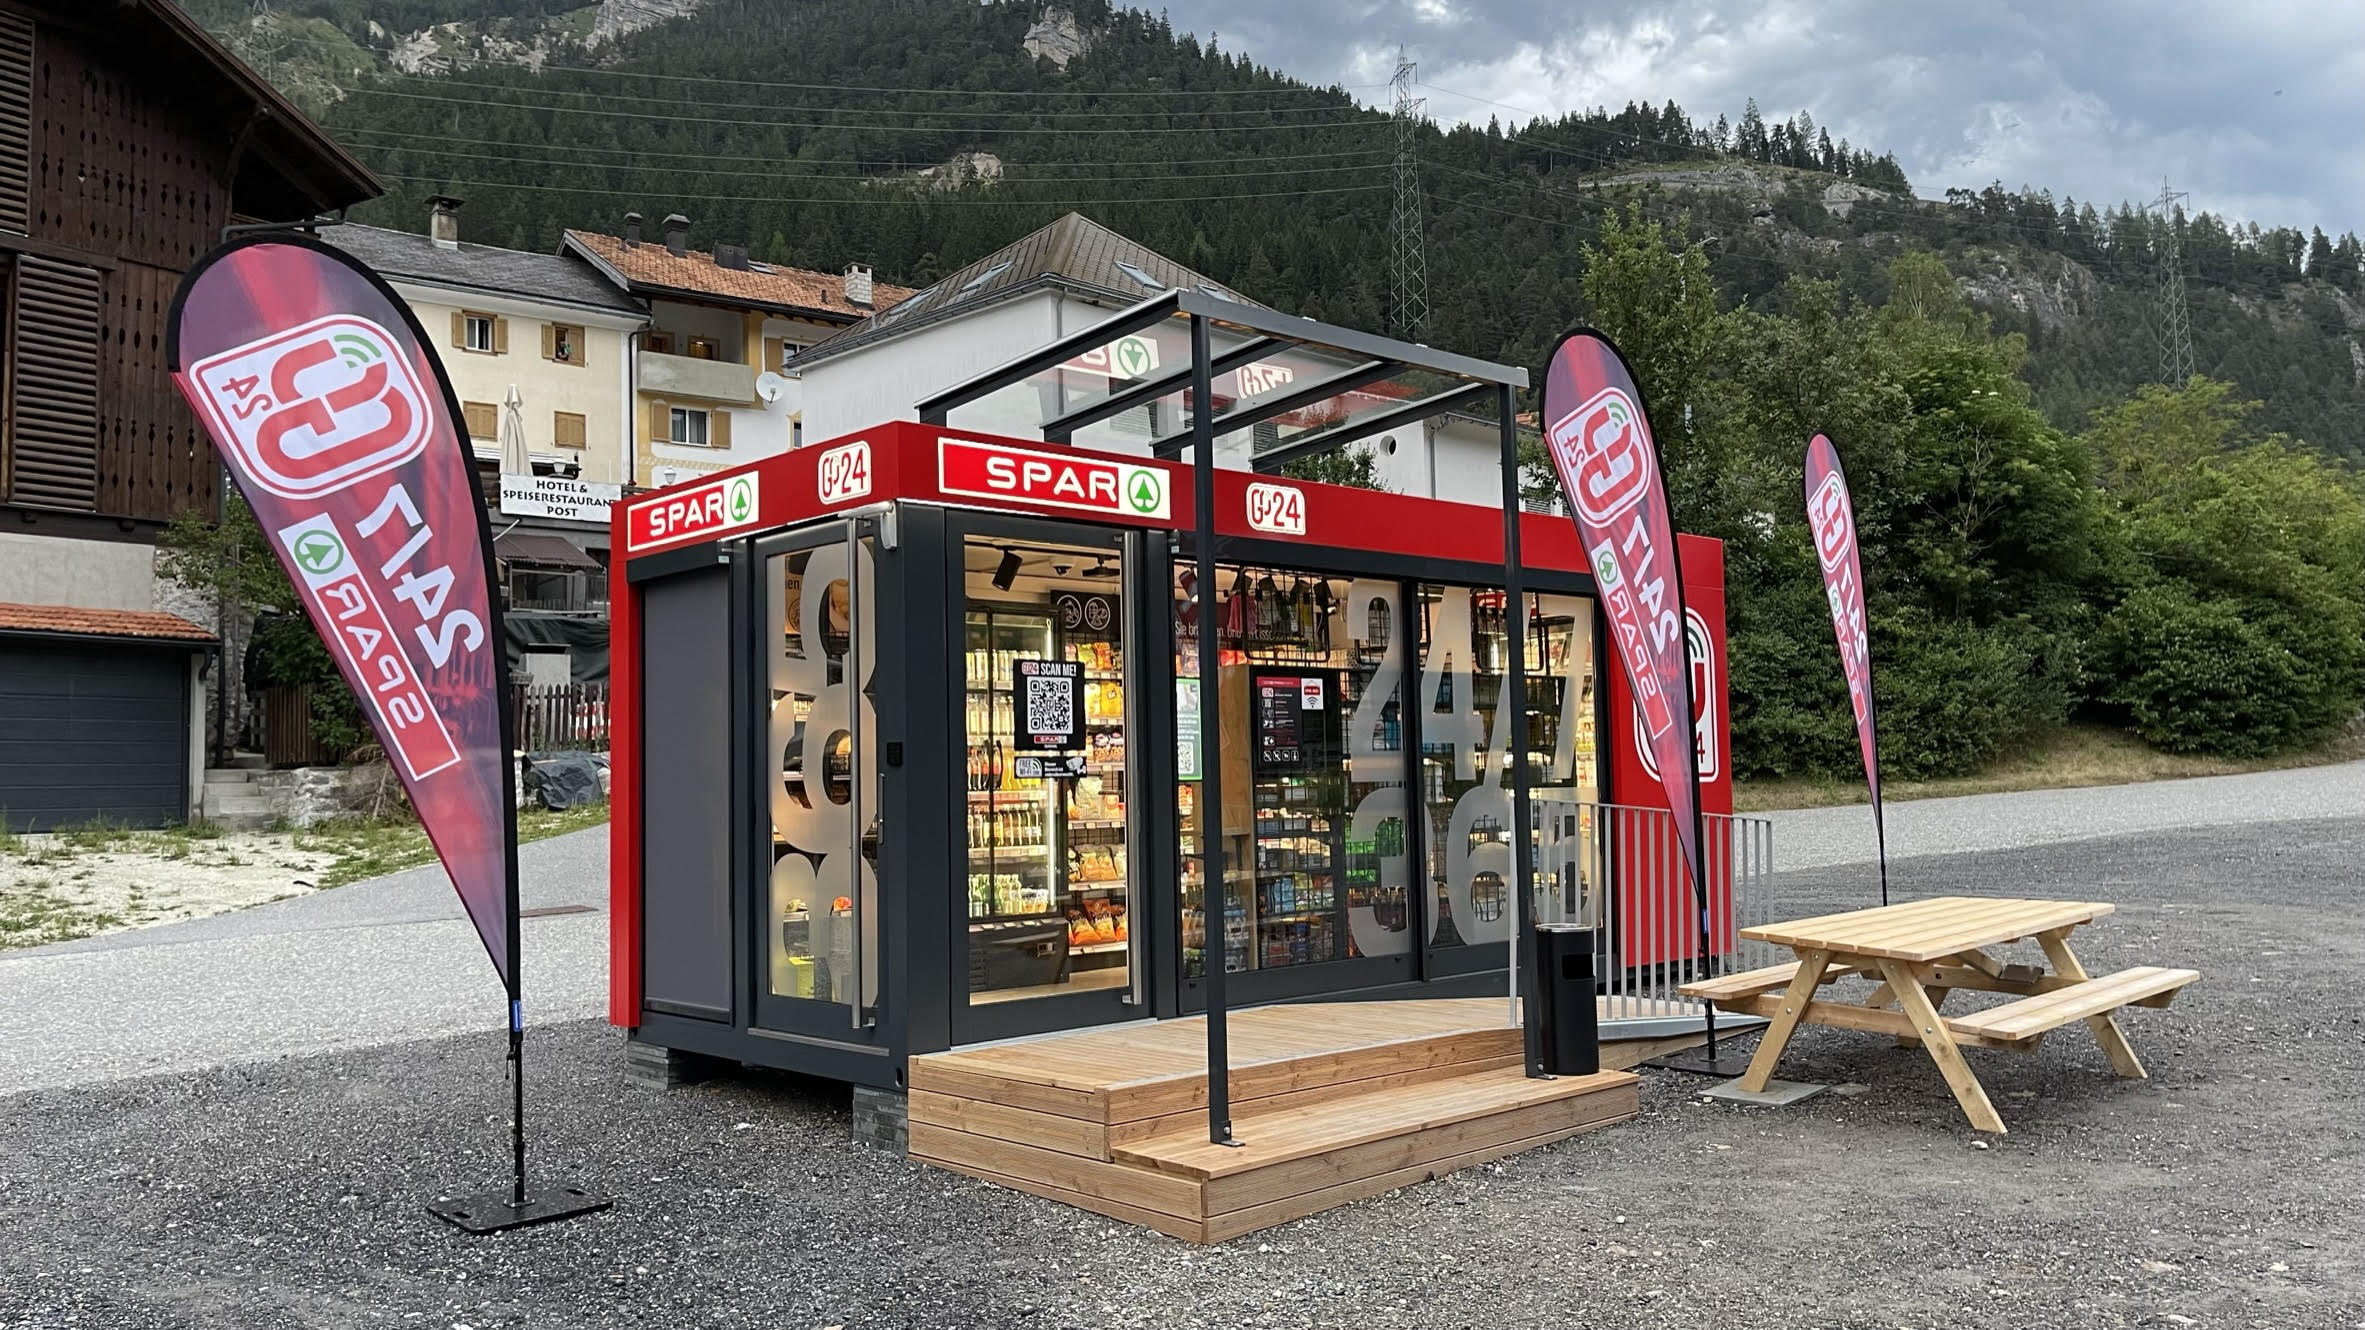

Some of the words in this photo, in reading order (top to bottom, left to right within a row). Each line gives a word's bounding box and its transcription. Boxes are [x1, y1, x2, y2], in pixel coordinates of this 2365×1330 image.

[536, 480, 577, 493] HOTEL
[579, 484, 588, 494] &
[986, 456, 1117, 503] SPAR
[503, 490, 612, 507] SPEISERESTAURAN
[547, 506, 579, 517] POST
[649, 491, 725, 537] SPAR
[1041, 663, 1061, 676] SCAN
[1062, 664, 1077, 676] ME!
